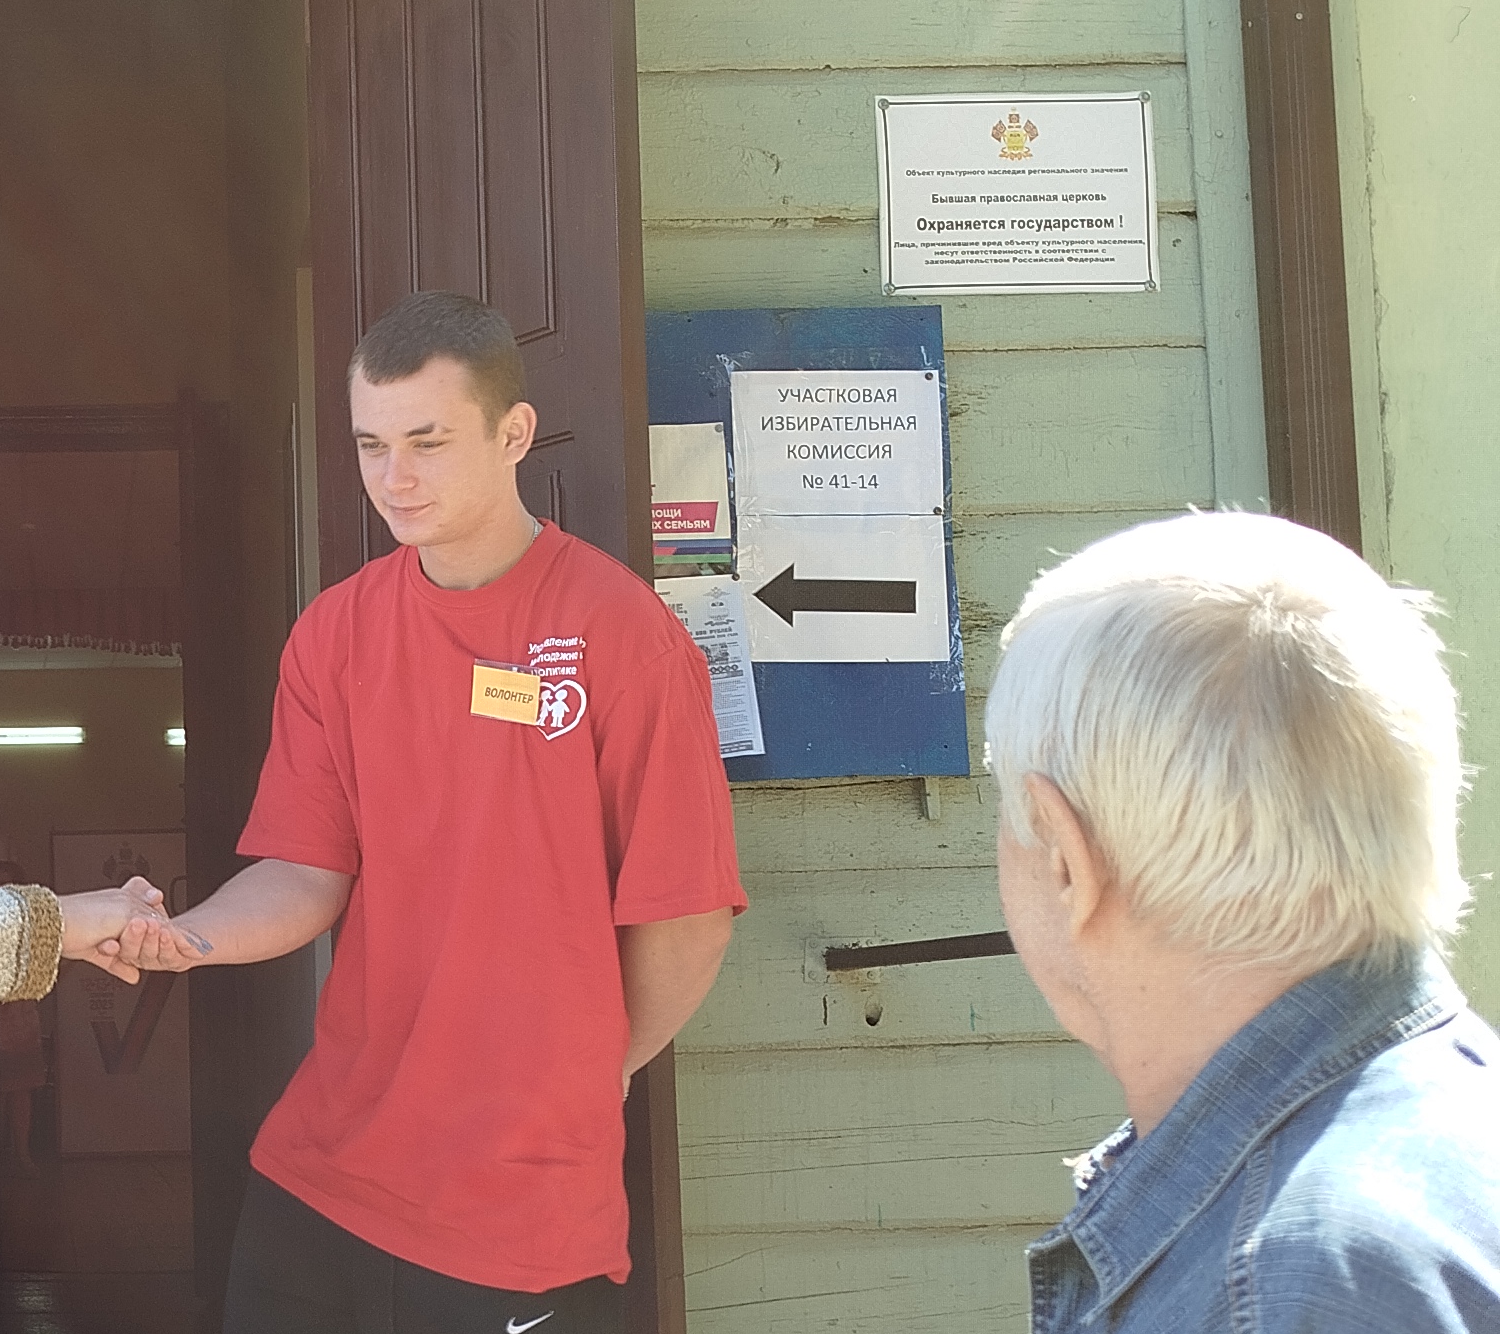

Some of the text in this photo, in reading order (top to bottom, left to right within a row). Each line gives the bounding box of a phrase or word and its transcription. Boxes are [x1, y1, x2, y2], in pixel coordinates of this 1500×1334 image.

[905, 169, 934, 177] Объект
[936, 169, 985, 177] культурного
[987, 168, 1026, 176] наследия
[1027, 167, 1088, 175] регионального
[931, 193, 1107, 205] Бывшая православная церковь
[916, 217, 1005, 234] Охраняется
[1010, 217, 1114, 232] государством
[778, 387, 897, 405] УЧАСТКОВАЯ
[761, 415, 917, 433] ИЗБИРАТЕЛЬНАЯ
[787, 444, 892, 460] КОМИССИЯ
[802, 474, 880, 490] № 41-14
[664, 519, 710, 530] СЕМЬЯМ
[484, 686, 534, 705] ВОЛОНТЕР
